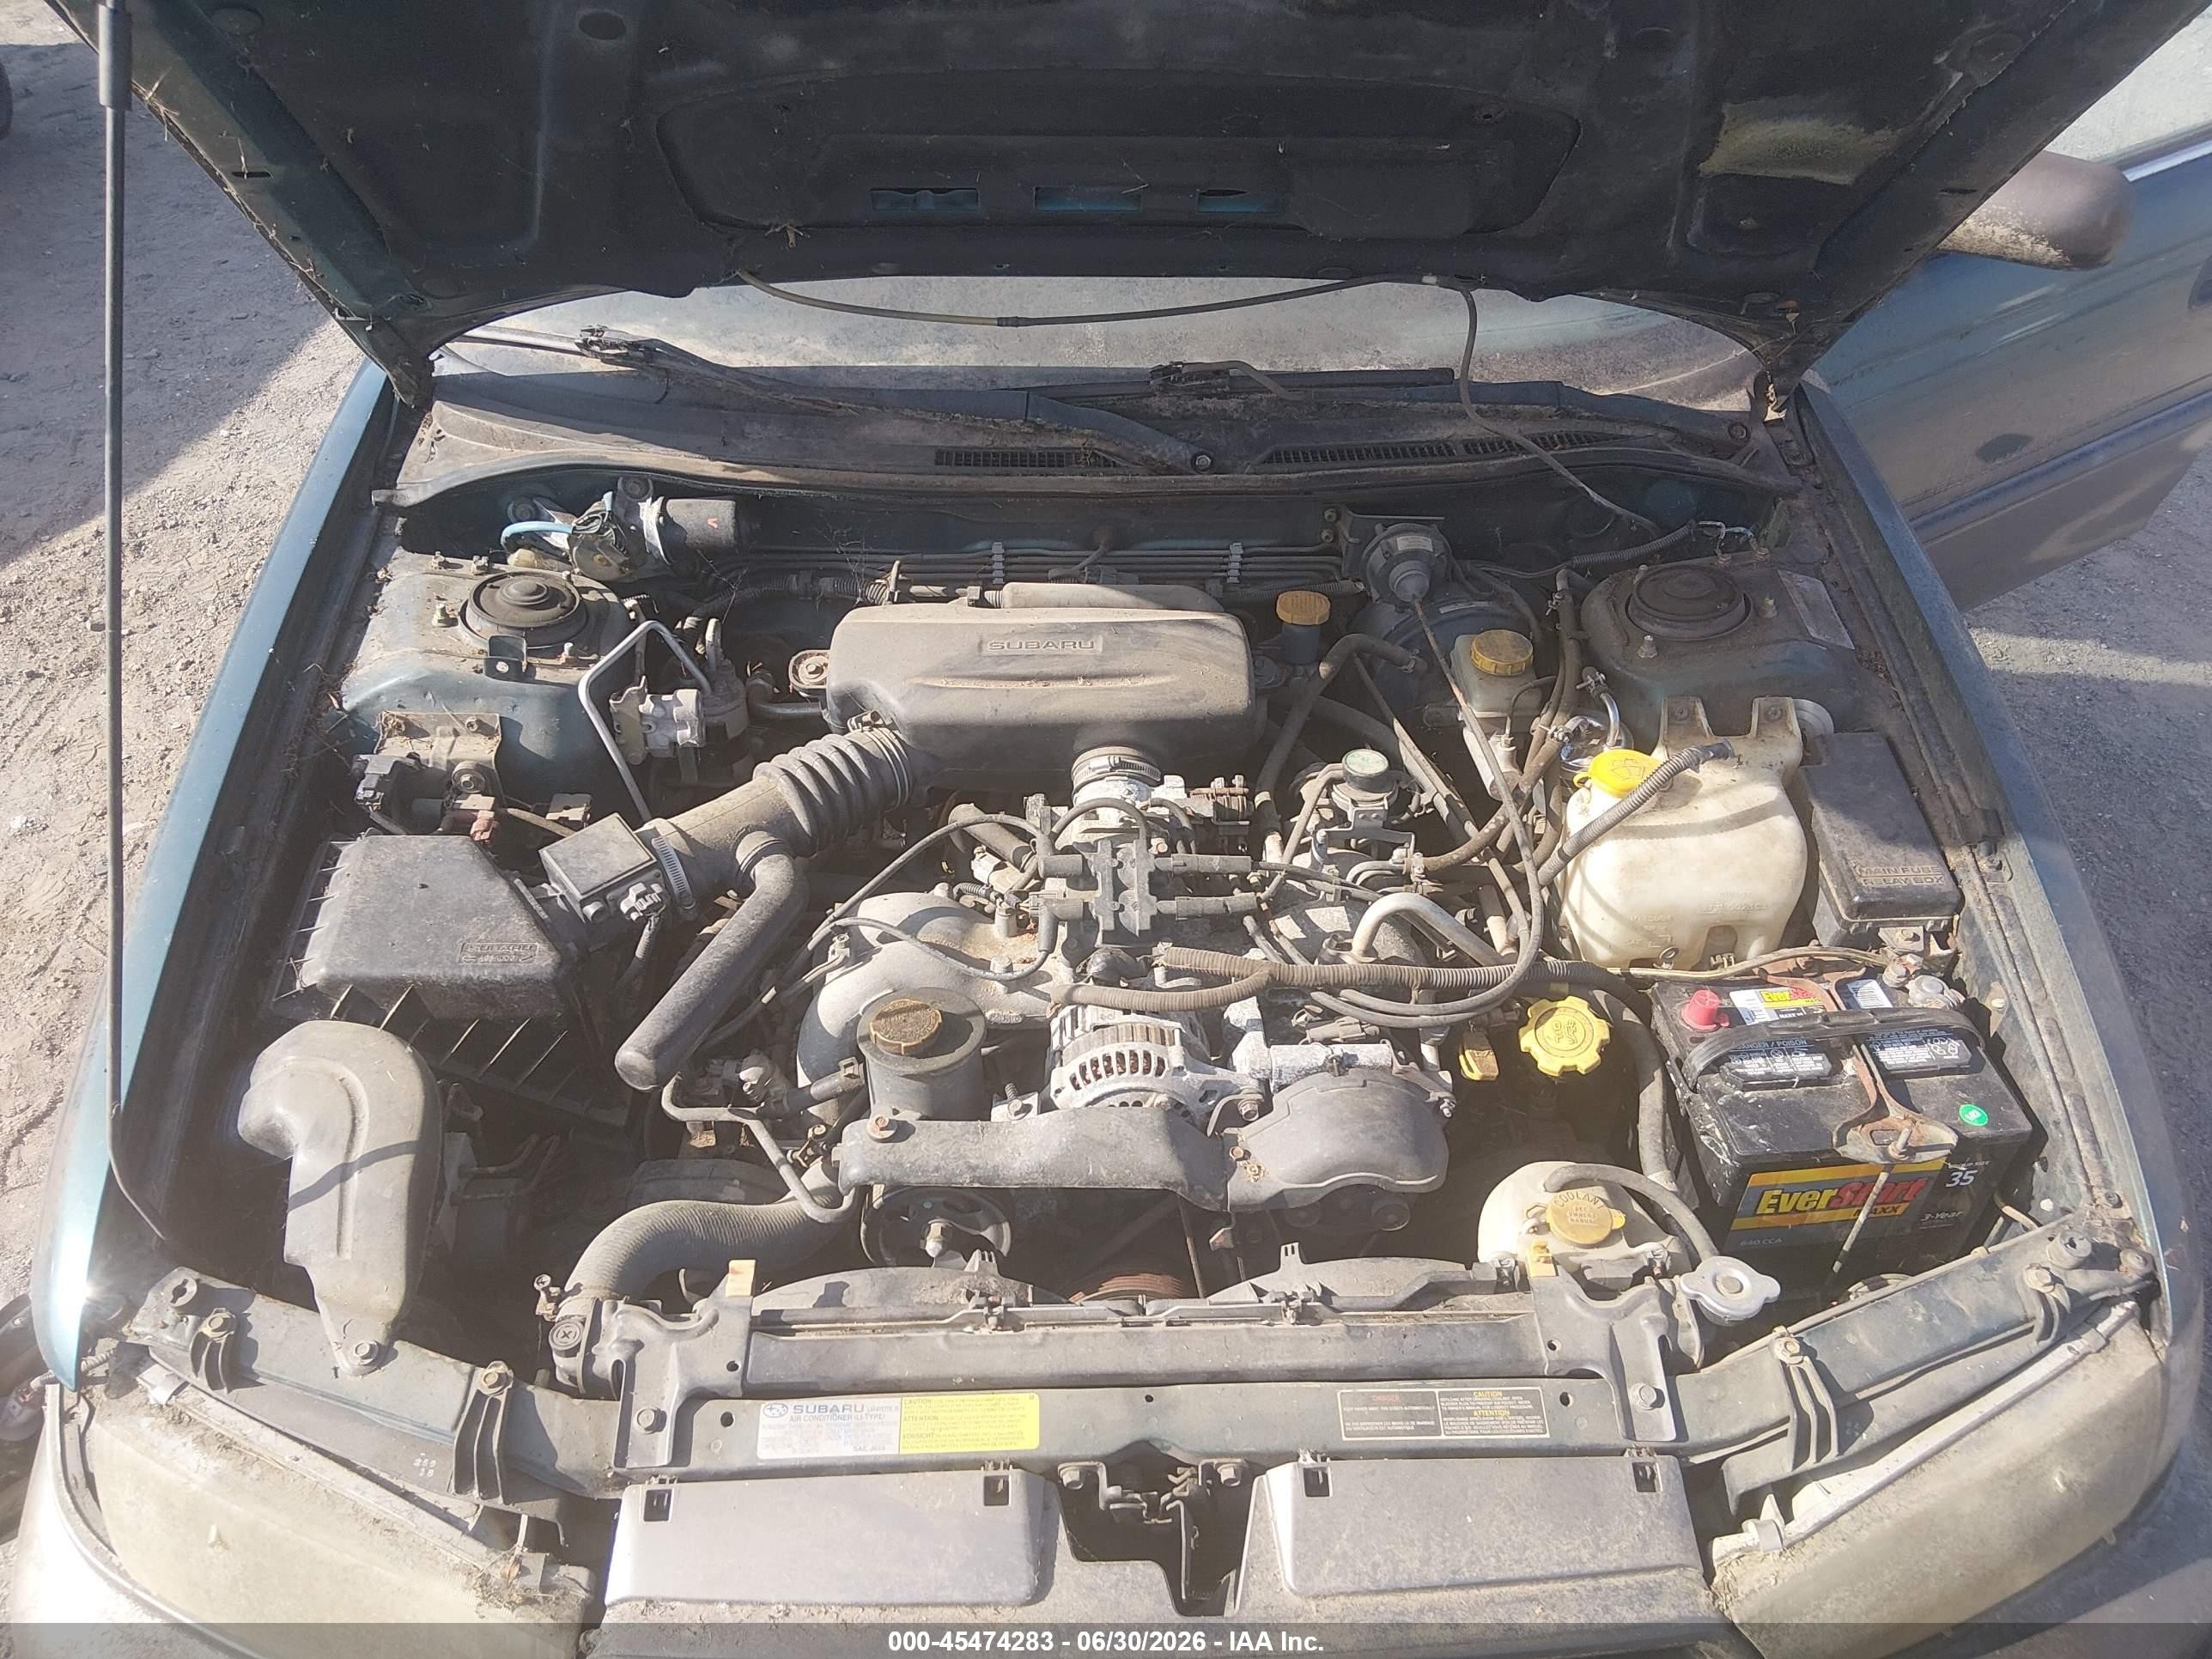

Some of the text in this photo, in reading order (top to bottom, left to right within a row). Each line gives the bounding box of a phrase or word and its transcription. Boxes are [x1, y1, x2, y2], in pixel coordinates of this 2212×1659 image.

[988, 640, 1095, 651] SUBARU
[1857, 865, 1941, 875] MAIN FUSE
[1863, 876, 1945, 886] RELAY BOX
[1778, 1038, 1808, 1047] POISON
[1945, 1170, 1978, 1188] 35
[1553, 1191, 1607, 1209] COOLANT
[1921, 1211, 1964, 1221] 3-Year
[793, 1404, 864, 1414] SUBARU
[804, 1413, 853, 1422] CONDITIONER
